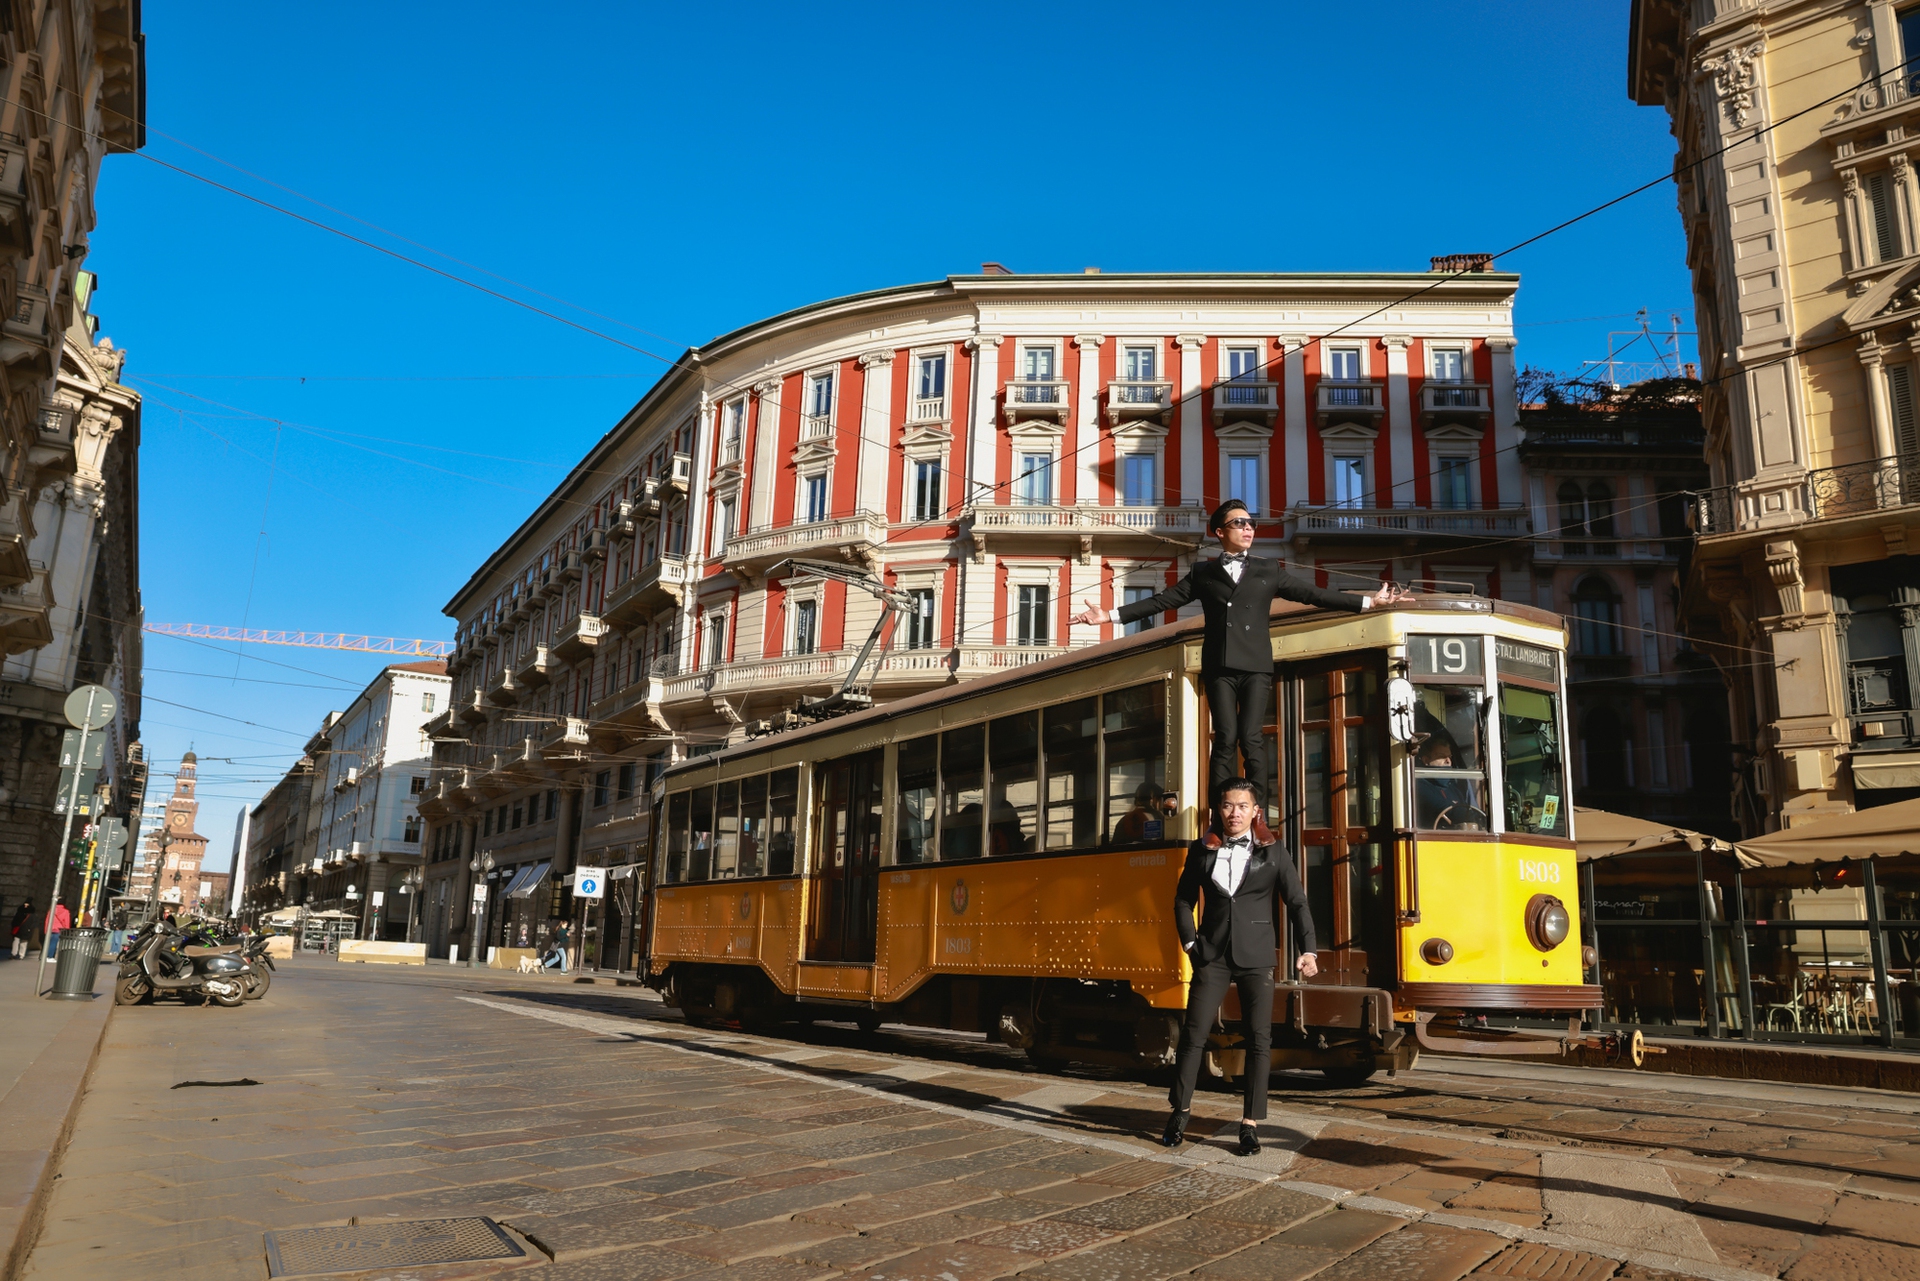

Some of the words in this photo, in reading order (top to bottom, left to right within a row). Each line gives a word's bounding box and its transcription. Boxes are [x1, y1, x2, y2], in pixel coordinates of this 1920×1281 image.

[1428, 637, 1466, 673] 19
[1515, 644, 1551, 667] LAMBRATE
[1543, 815, 1553, 828] 19
[1129, 853, 1166, 867] entrata
[1518, 859, 1560, 884] 1803
[945, 937, 971, 954] 1803
